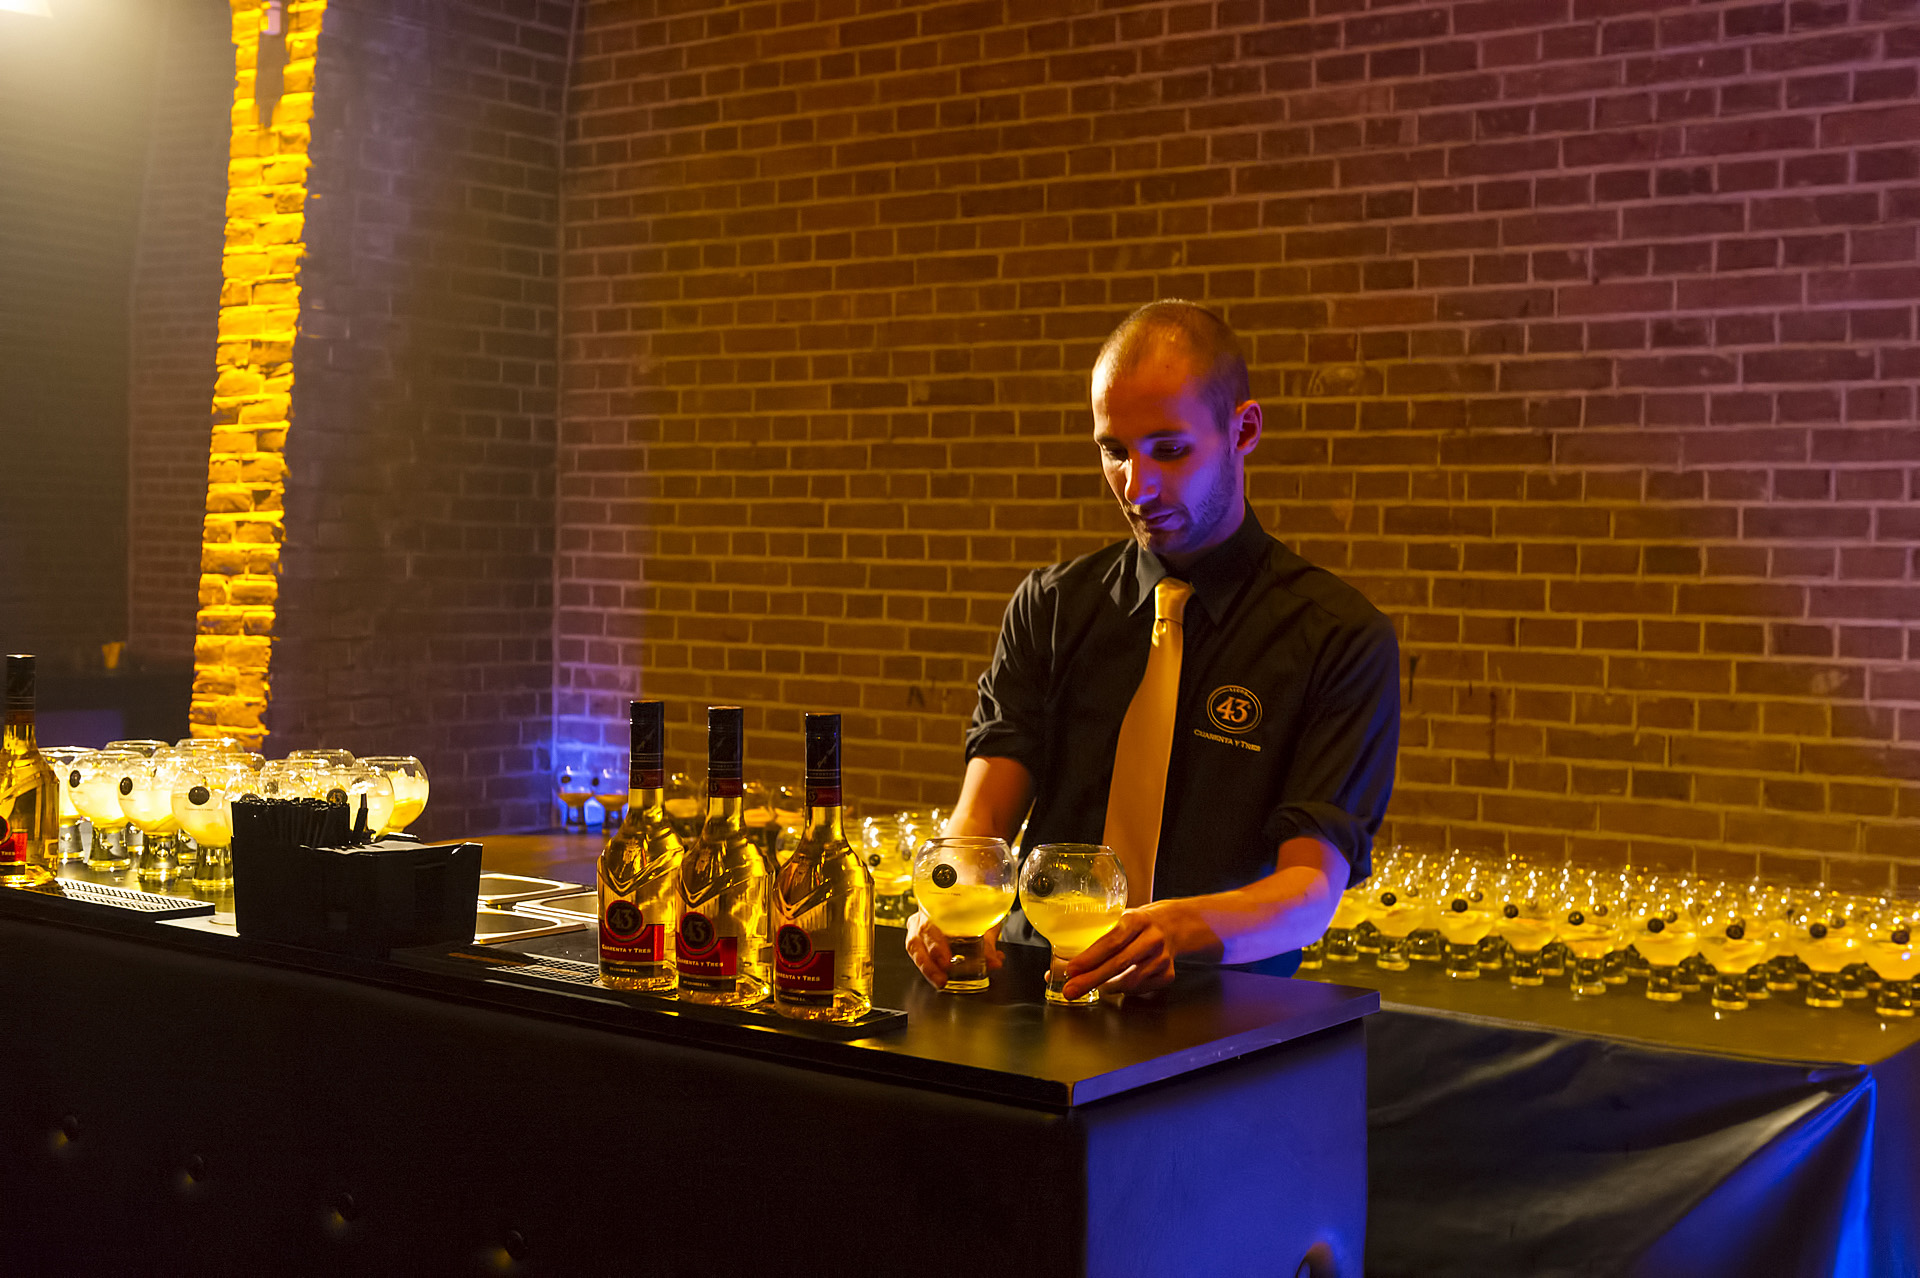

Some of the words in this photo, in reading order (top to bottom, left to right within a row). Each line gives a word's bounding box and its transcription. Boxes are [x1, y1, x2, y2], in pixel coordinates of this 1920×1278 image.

[1216, 696, 1251, 723] 43
[1193, 729, 1233, 745] CUARENTA
[610, 908, 634, 930] 43
